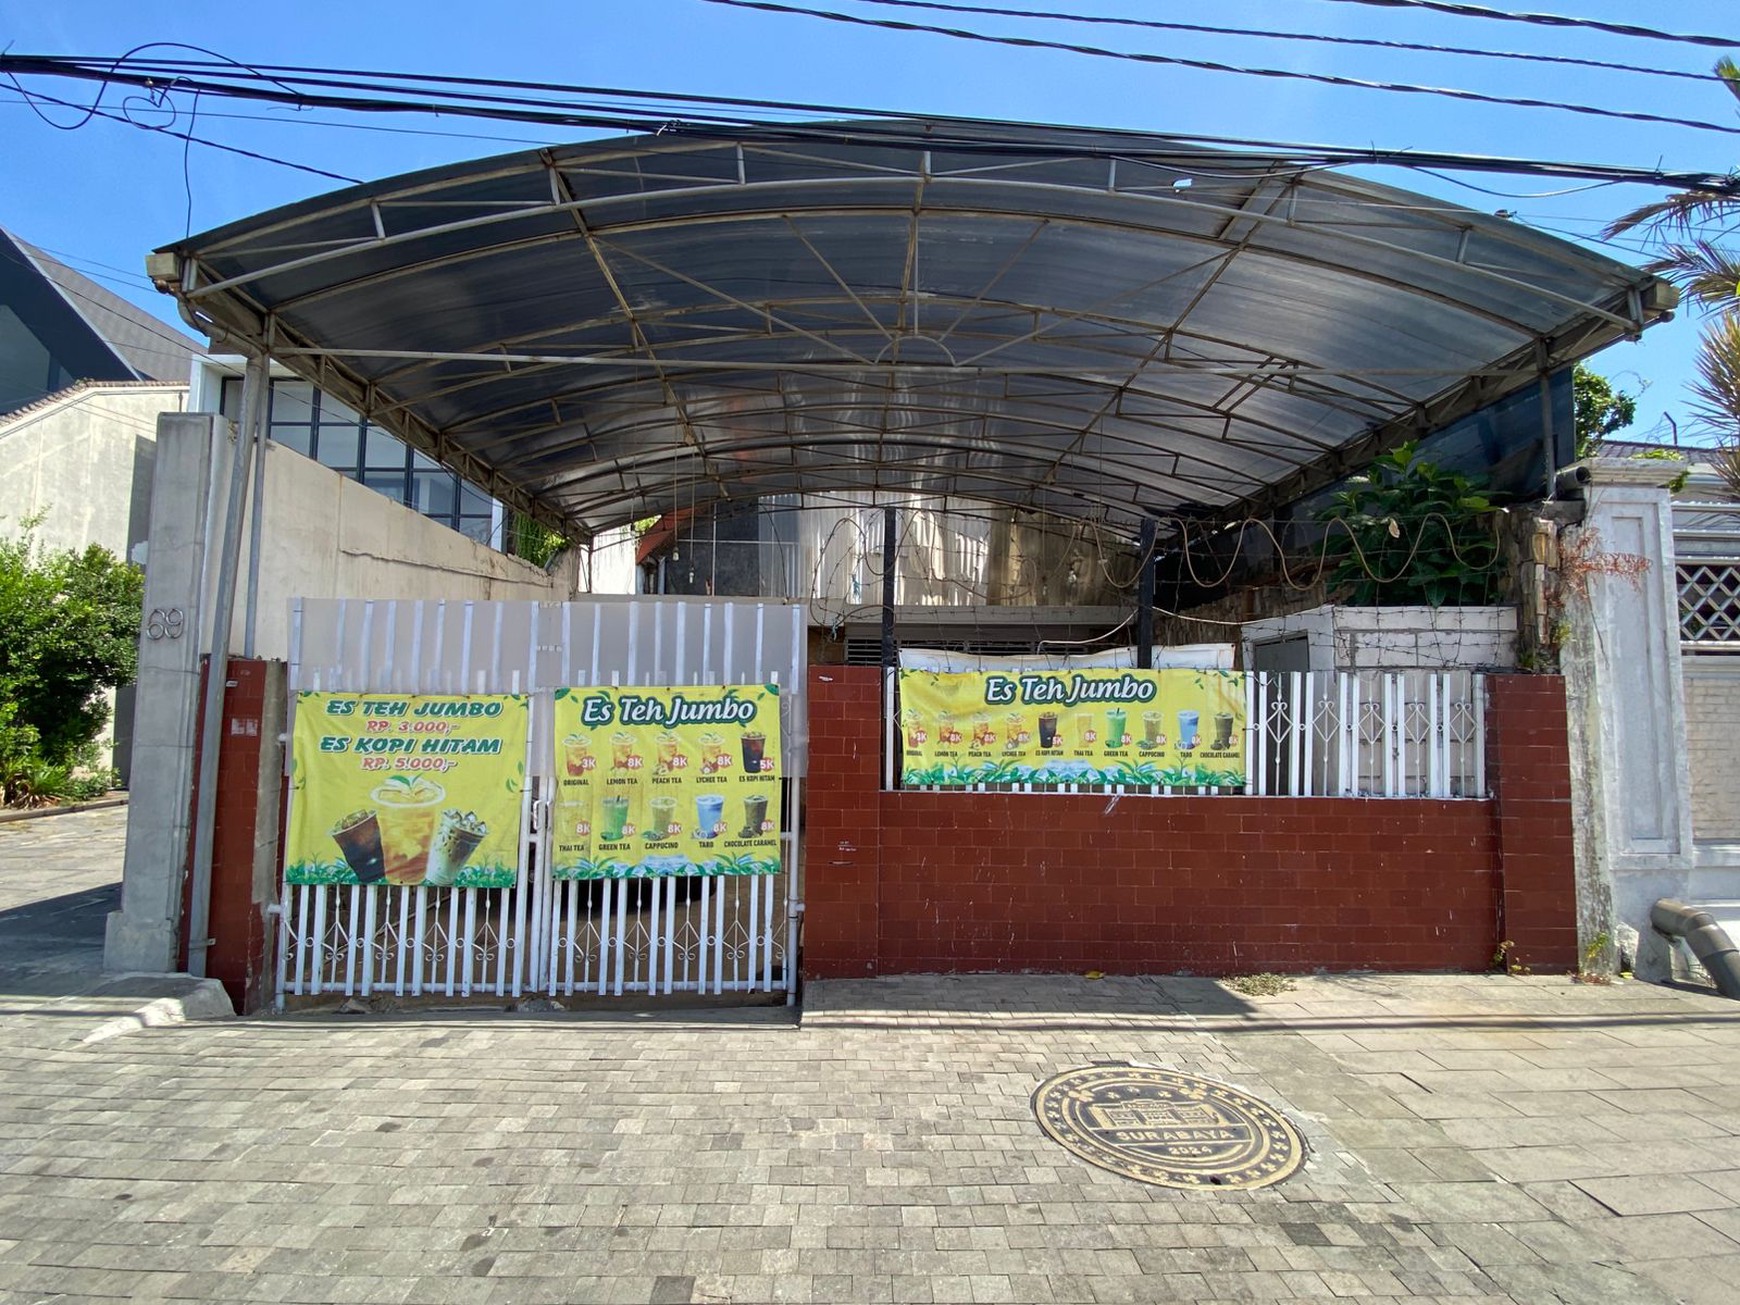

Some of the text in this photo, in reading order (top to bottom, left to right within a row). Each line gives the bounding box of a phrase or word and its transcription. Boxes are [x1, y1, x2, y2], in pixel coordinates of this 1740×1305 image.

[146, 609, 184, 640] 69
[986, 676, 1154, 703] Es Teh Jumbo
[326, 700, 503, 717] ES TEH JUMBO
[583, 697, 755, 725] Es Teh Jumbo
[398, 721, 459, 734] 3.000,-
[320, 737, 502, 754] ES KOPI HITAM
[394, 758, 457, 772] 5.000,-
[582, 756, 597, 768] 3K
[627, 756, 643, 768] 8K
[672, 756, 688, 767] 8K
[717, 755, 732, 766] 8K
[760, 759, 775, 769] 5K
[563, 779, 590, 787] ORIGINAL
[747, 775, 759, 783] KOPI
[576, 823, 591, 833] 8K
[621, 825, 636, 835] 8K
[667, 823, 682, 833] 8K
[713, 823, 727, 833] 8K
[760, 821, 775, 831] 8K
[645, 842, 679, 850] CAPPUCINO
[724, 839, 777, 848] CHOCOLATE CARAMEL
[1115, 1129, 1235, 1141] SURABAYA
[1168, 1145, 1212, 1155] 2024
